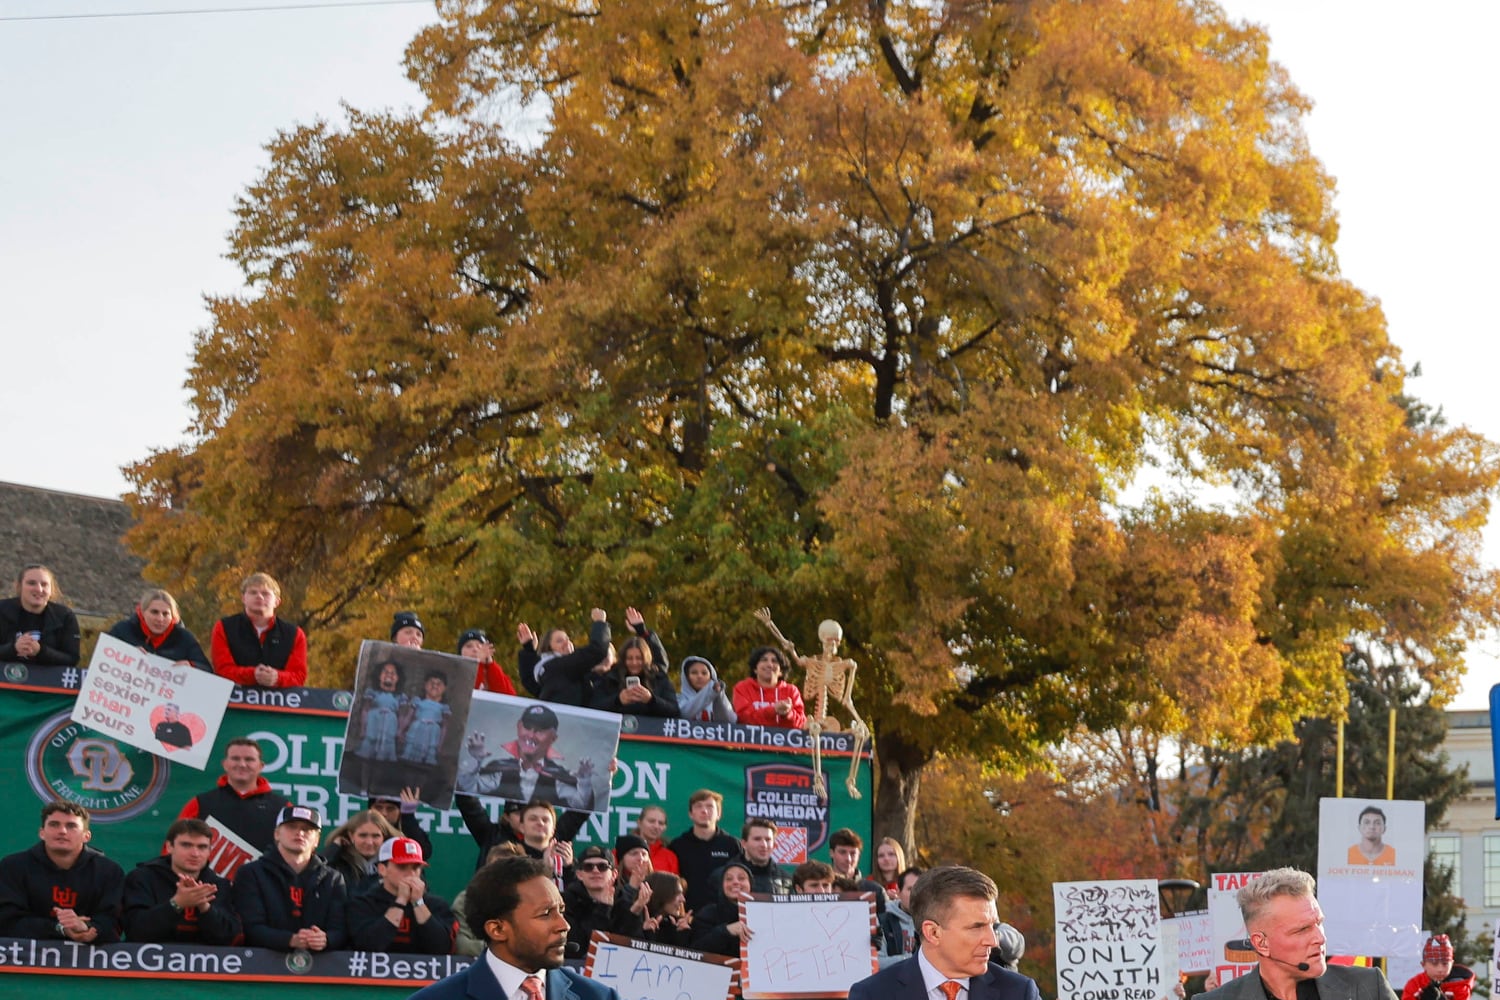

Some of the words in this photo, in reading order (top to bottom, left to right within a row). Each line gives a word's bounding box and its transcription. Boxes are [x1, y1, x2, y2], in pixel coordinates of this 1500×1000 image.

[103, 647, 136, 667] our
[138, 655, 188, 686] head
[98, 661, 156, 693] coach
[158, 683, 175, 700] is
[93, 676, 150, 707] sexier
[88, 690, 132, 718] than
[81, 705, 136, 737] yours
[765, 773, 810, 787] ESPN
[757, 791, 818, 806] COLLEGE
[746, 803, 827, 821] GAMEDAY
[772, 894, 789, 902] THE
[790, 894, 815, 902] HOME
[816, 893, 840, 902] DEPOT
[630, 940, 648, 951] THE
[649, 943, 674, 956] HOME
[674, 949, 704, 961] DEPOT
[1068, 944, 1157, 965] ONLY
[1060, 968, 1160, 992] SMITH
[1124, 987, 1156, 1000] READ
